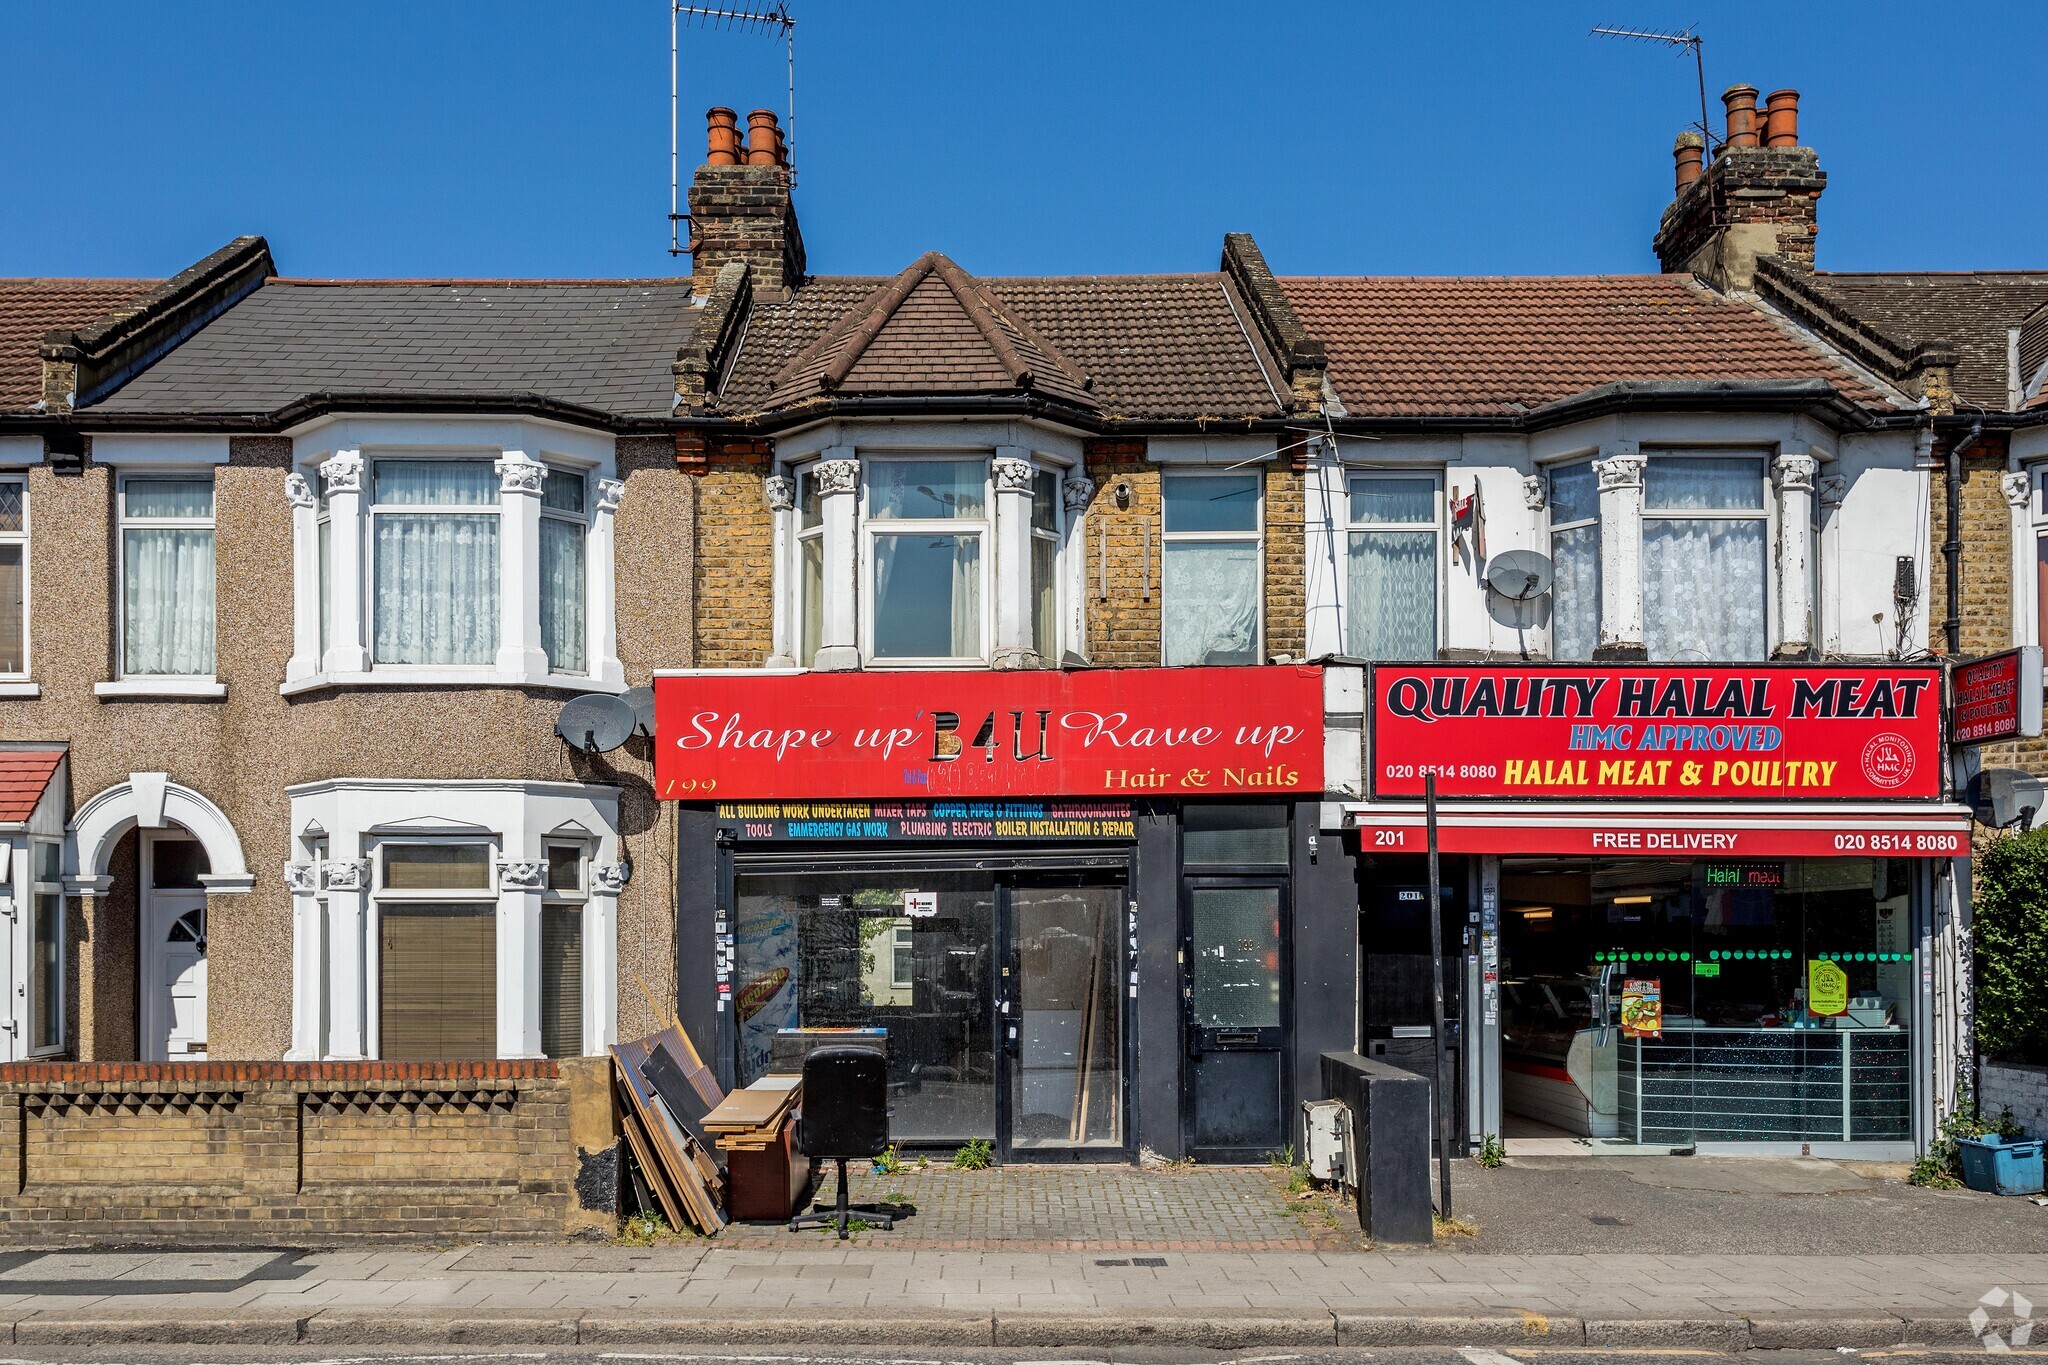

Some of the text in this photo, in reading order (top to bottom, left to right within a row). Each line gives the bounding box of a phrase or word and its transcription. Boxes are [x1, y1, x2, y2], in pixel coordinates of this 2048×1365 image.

[1966, 662, 2004, 685] QUALITY
[1387, 677, 1932, 723] QUALITY HALAL MEAT
[1957, 680, 2014, 706] HALAL MEAT
[1961, 700, 2010, 722] & POULTRY
[677, 710, 1304, 763] Shape up B4U Rave up
[1973, 722, 1992, 737] 8514
[1995, 718, 2016, 732] 8080
[1567, 724, 1783, 752] HMC APPROVED
[1865, 736, 1912, 763] HALAL MONITORING
[1104, 764, 1299, 788] Hair & Nails
[1386, 765, 1414, 778] 020
[1460, 765, 1497, 778] 8080
[1504, 759, 1838, 787] HALAL MEAT & POULTRY
[1866, 767, 1911, 785] COMMITTEE UK
[1877, 763, 1900, 772] HMC
[664, 779, 717, 795] 199
[719, 803, 736, 819] ALL
[737, 803, 780, 819] BUILDING
[782, 803, 810, 819] WORK
[811, 803, 870, 819] UNDERTAKEN
[874, 803, 903, 818] MIXER
[905, 803, 927, 818] TAPS
[933, 803, 967, 818] COPPER
[970, 803, 994, 818] PIPES
[996, 803, 1002, 818] &
[1005, 803, 1044, 818] FITTINGS
[745, 821, 1135, 838] TOOLS EMMERGENCY GAS WORK PLUMBING ELECTRIC BOILER INSTALLATION & REPAIR
[1375, 830, 1405, 846] 201
[1592, 832, 1738, 850] FREE DELIVERY
[1834, 834, 1958, 851] 020 8514 8080
[1707, 868, 1740, 883] Halal
